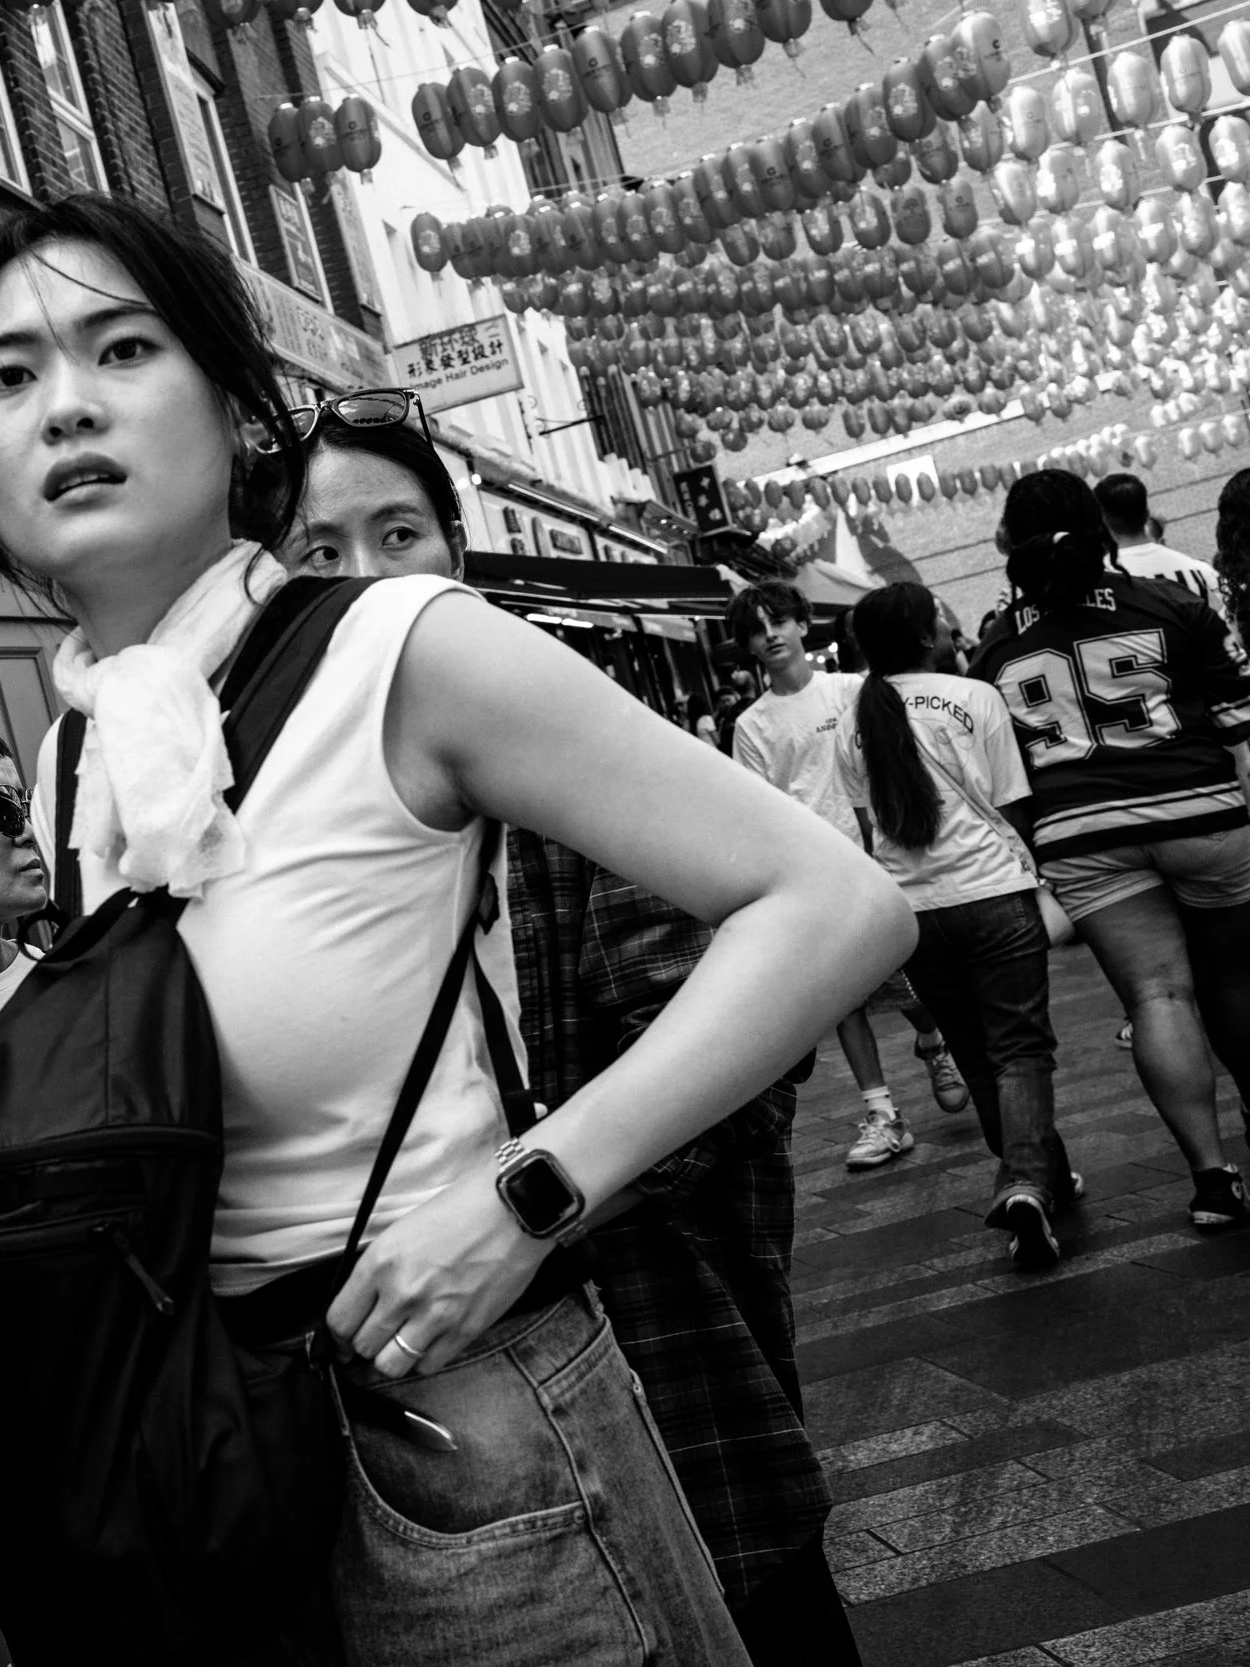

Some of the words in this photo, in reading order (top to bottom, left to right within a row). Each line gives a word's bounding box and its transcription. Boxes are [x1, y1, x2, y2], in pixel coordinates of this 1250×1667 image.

[446, 370, 467, 382] Hair
[470, 358, 509, 375] Design
[1015, 604, 1040, 635] LOS
[994, 628, 1182, 770] 95
